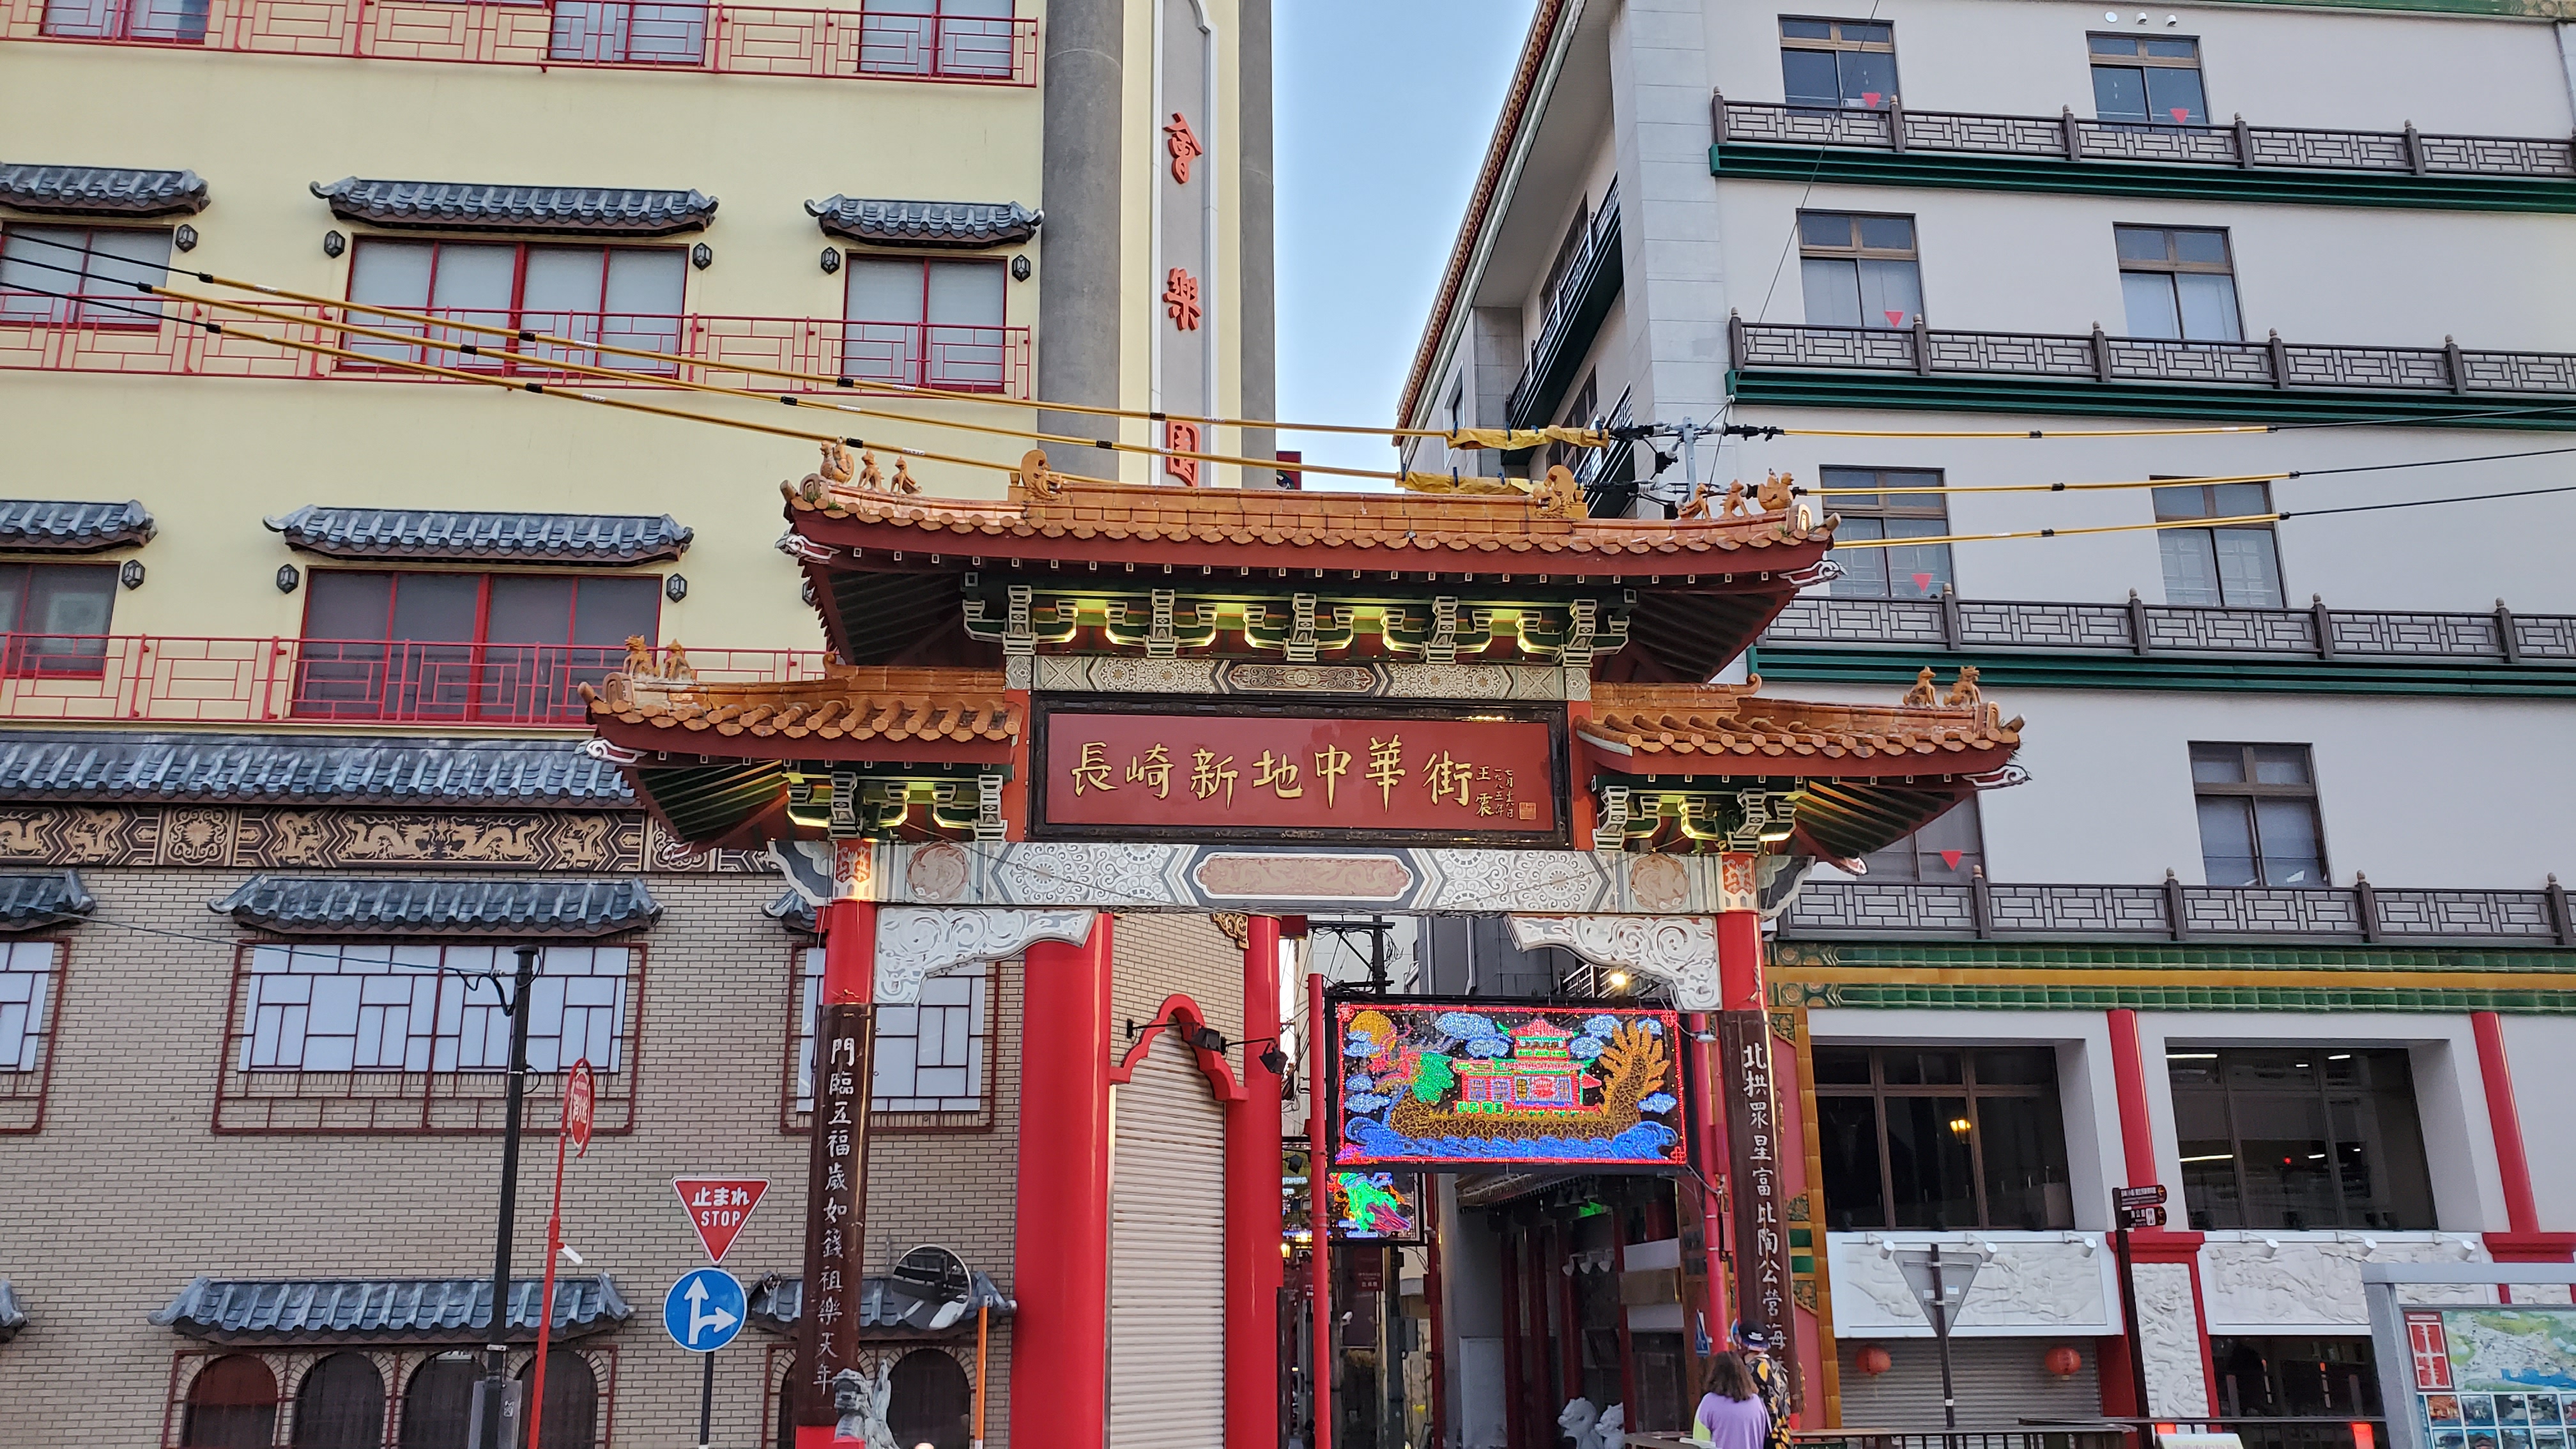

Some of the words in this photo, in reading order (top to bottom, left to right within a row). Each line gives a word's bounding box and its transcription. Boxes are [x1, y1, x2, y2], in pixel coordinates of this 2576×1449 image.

[1071, 734, 1473, 812] 長崎新地中華街
[1475, 766, 1495, 817] 王震
[692, 1186, 750, 1208] 止まれ
[701, 1211, 740, 1227] STOP
